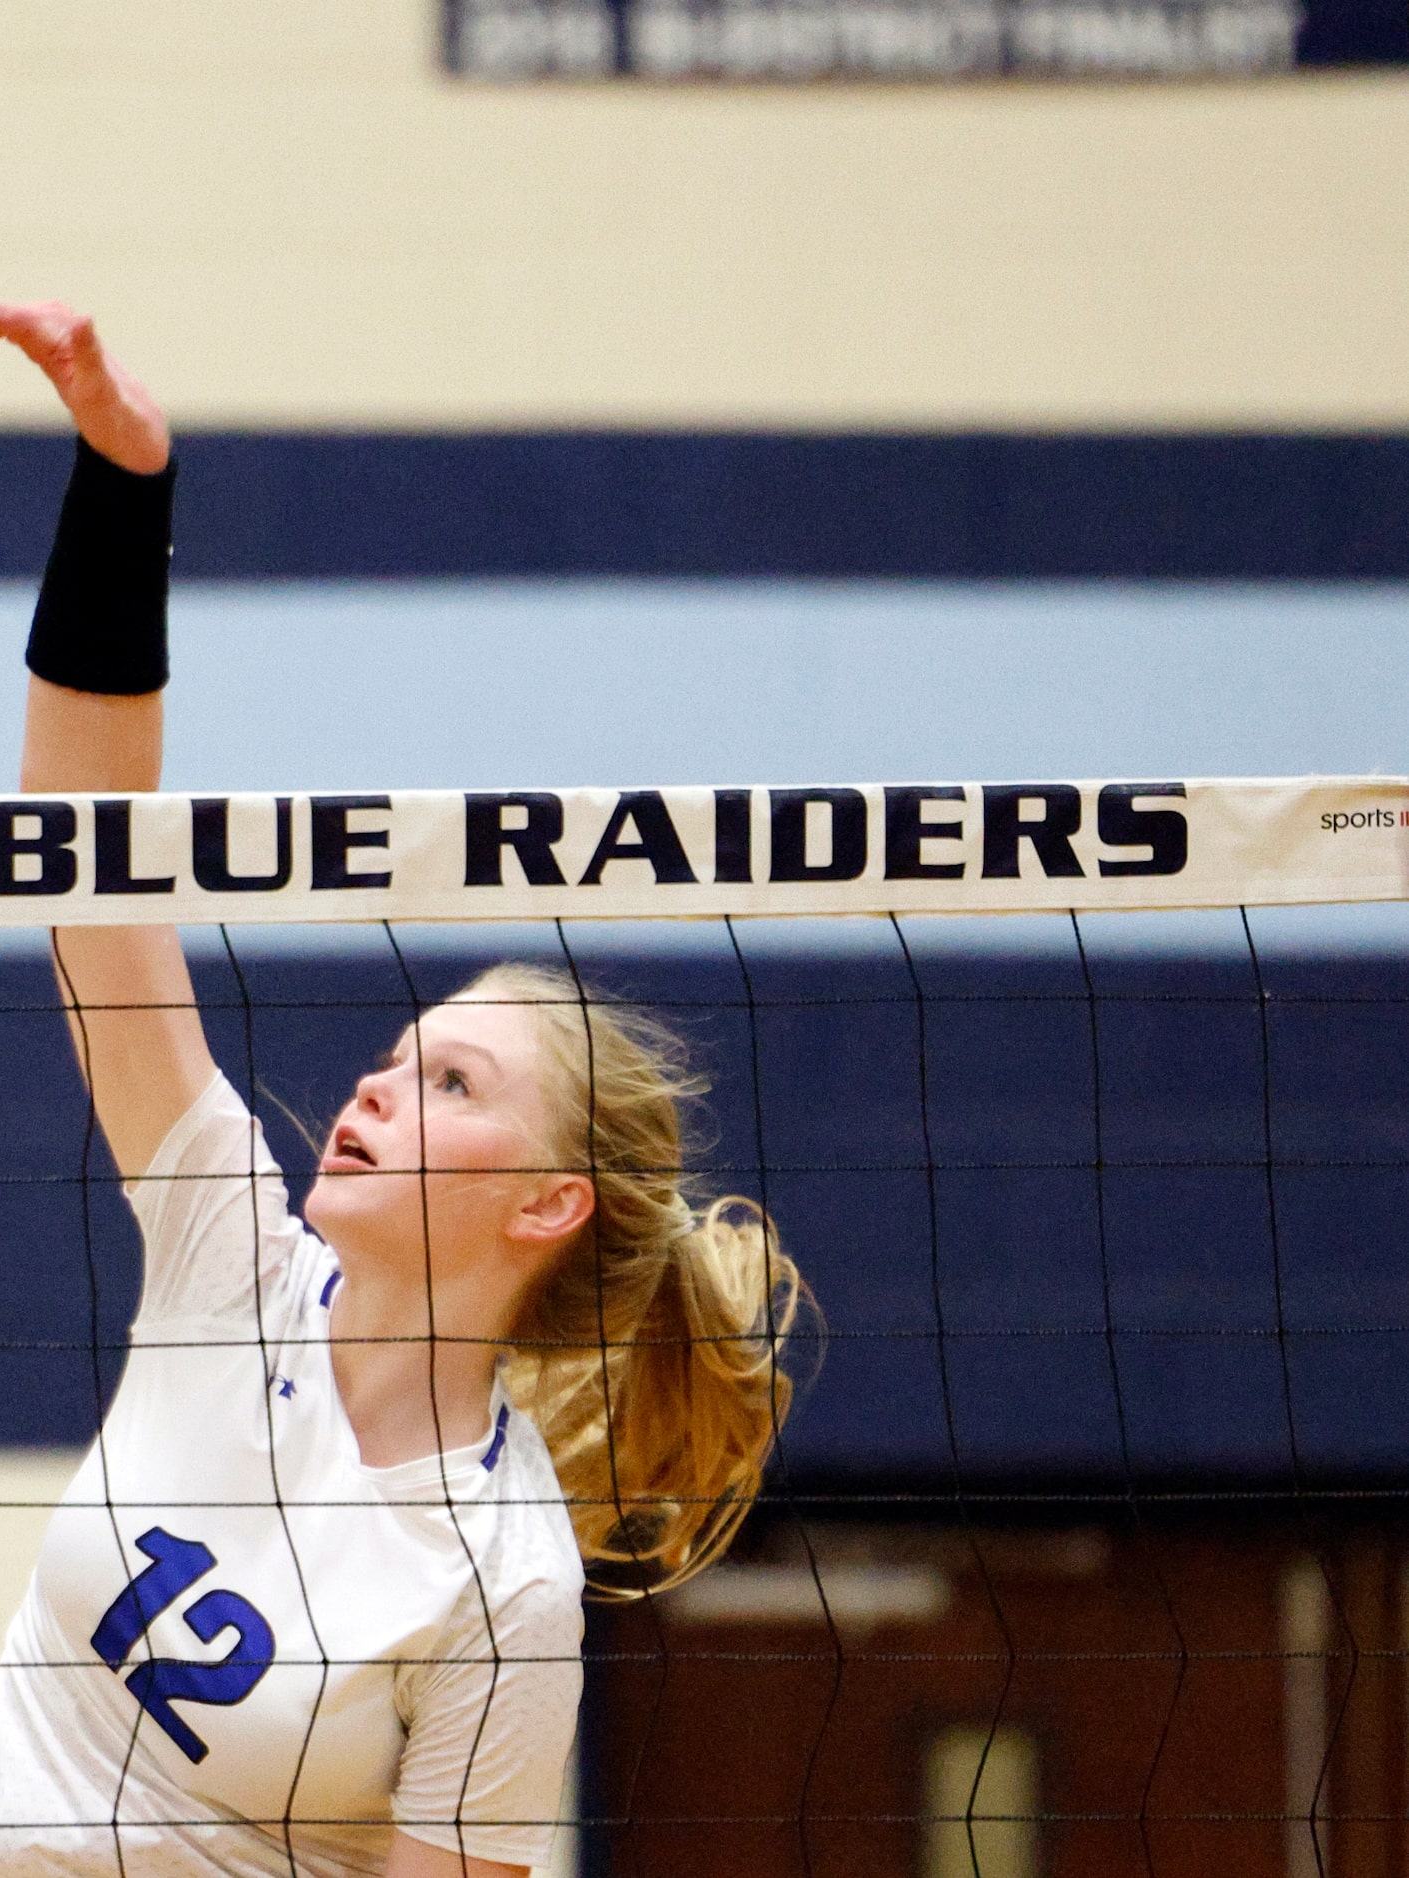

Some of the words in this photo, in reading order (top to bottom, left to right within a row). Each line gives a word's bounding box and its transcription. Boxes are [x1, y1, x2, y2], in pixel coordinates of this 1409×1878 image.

[463, 782, 1188, 886] RAIDERS
[1321, 808, 1395, 834] sports
[91, 1526, 276, 1765] 12
